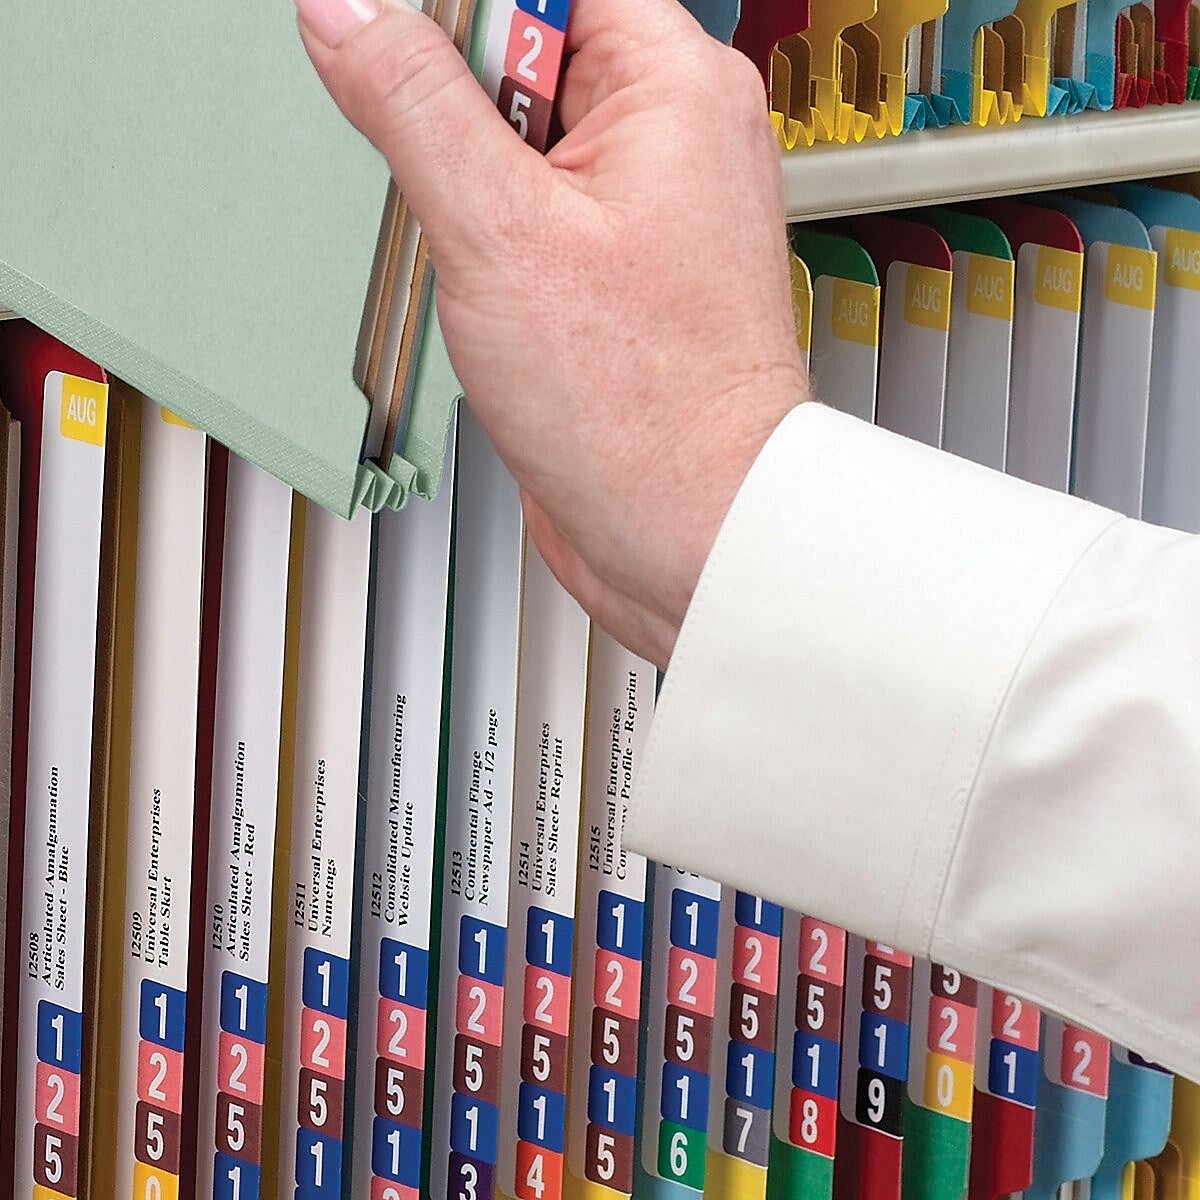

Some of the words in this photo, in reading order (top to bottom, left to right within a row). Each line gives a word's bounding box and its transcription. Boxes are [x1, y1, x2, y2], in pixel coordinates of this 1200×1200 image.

[1043, 264, 1072, 294] AUG
[1113, 262, 1142, 291] AUG
[67, 394, 96, 425] AUG
[389, 694, 406, 815] Manufacturing
[312, 760, 326, 851] Enterprises
[401, 802, 414, 858] Update
[148, 789, 161, 881] Enterprises
[160, 876, 171, 918] Skirt
[308, 856, 320, 931] Universal
[322, 859, 337, 937] Nametags
[371, 872, 383, 920] 12512
[384, 819, 401, 923] Consolidated
[399, 865, 411, 926] Website
[143, 886, 157, 963] Universal
[294, 883, 306, 928] 12511
[131, 911, 142, 960] 12509
[158, 923, 169, 968] Table
